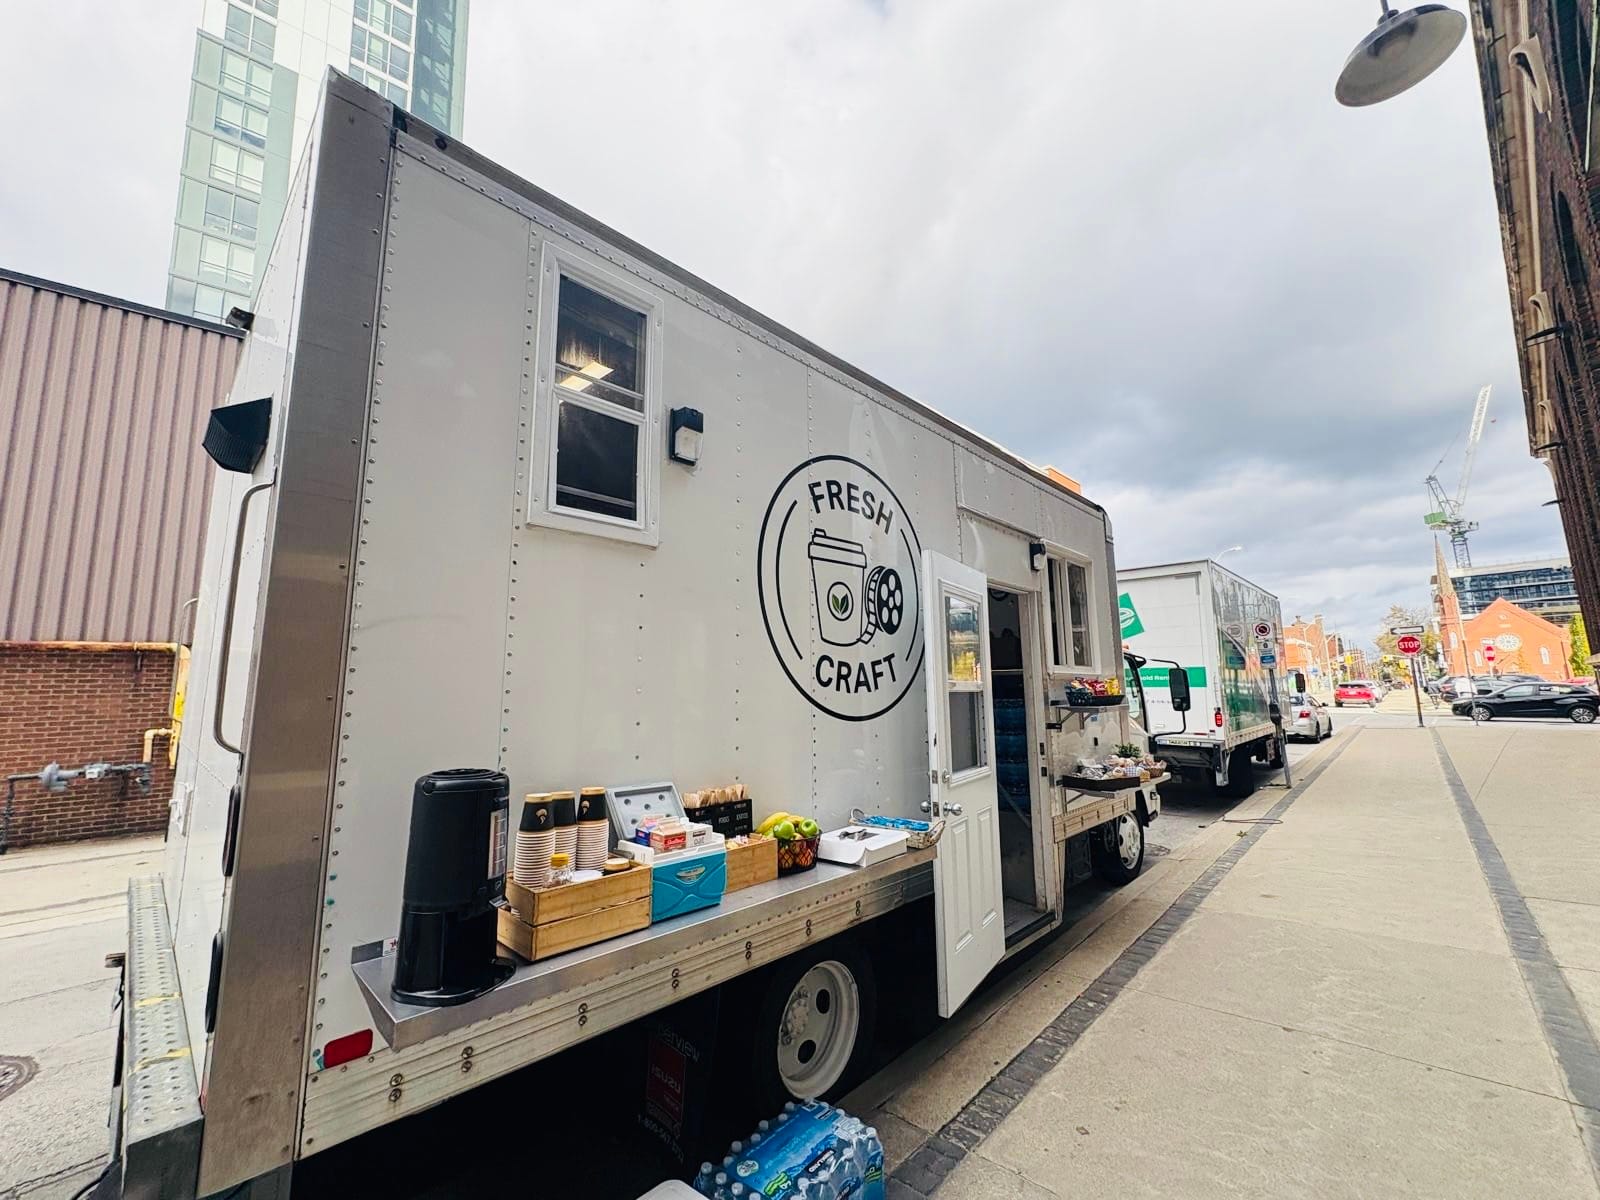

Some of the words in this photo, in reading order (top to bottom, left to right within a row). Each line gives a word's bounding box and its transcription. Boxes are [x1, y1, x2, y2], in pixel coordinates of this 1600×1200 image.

[808, 480, 893, 534] FRESH
[1398, 641, 1420, 649] STOP
[815, 653, 897, 694] CRAFT
